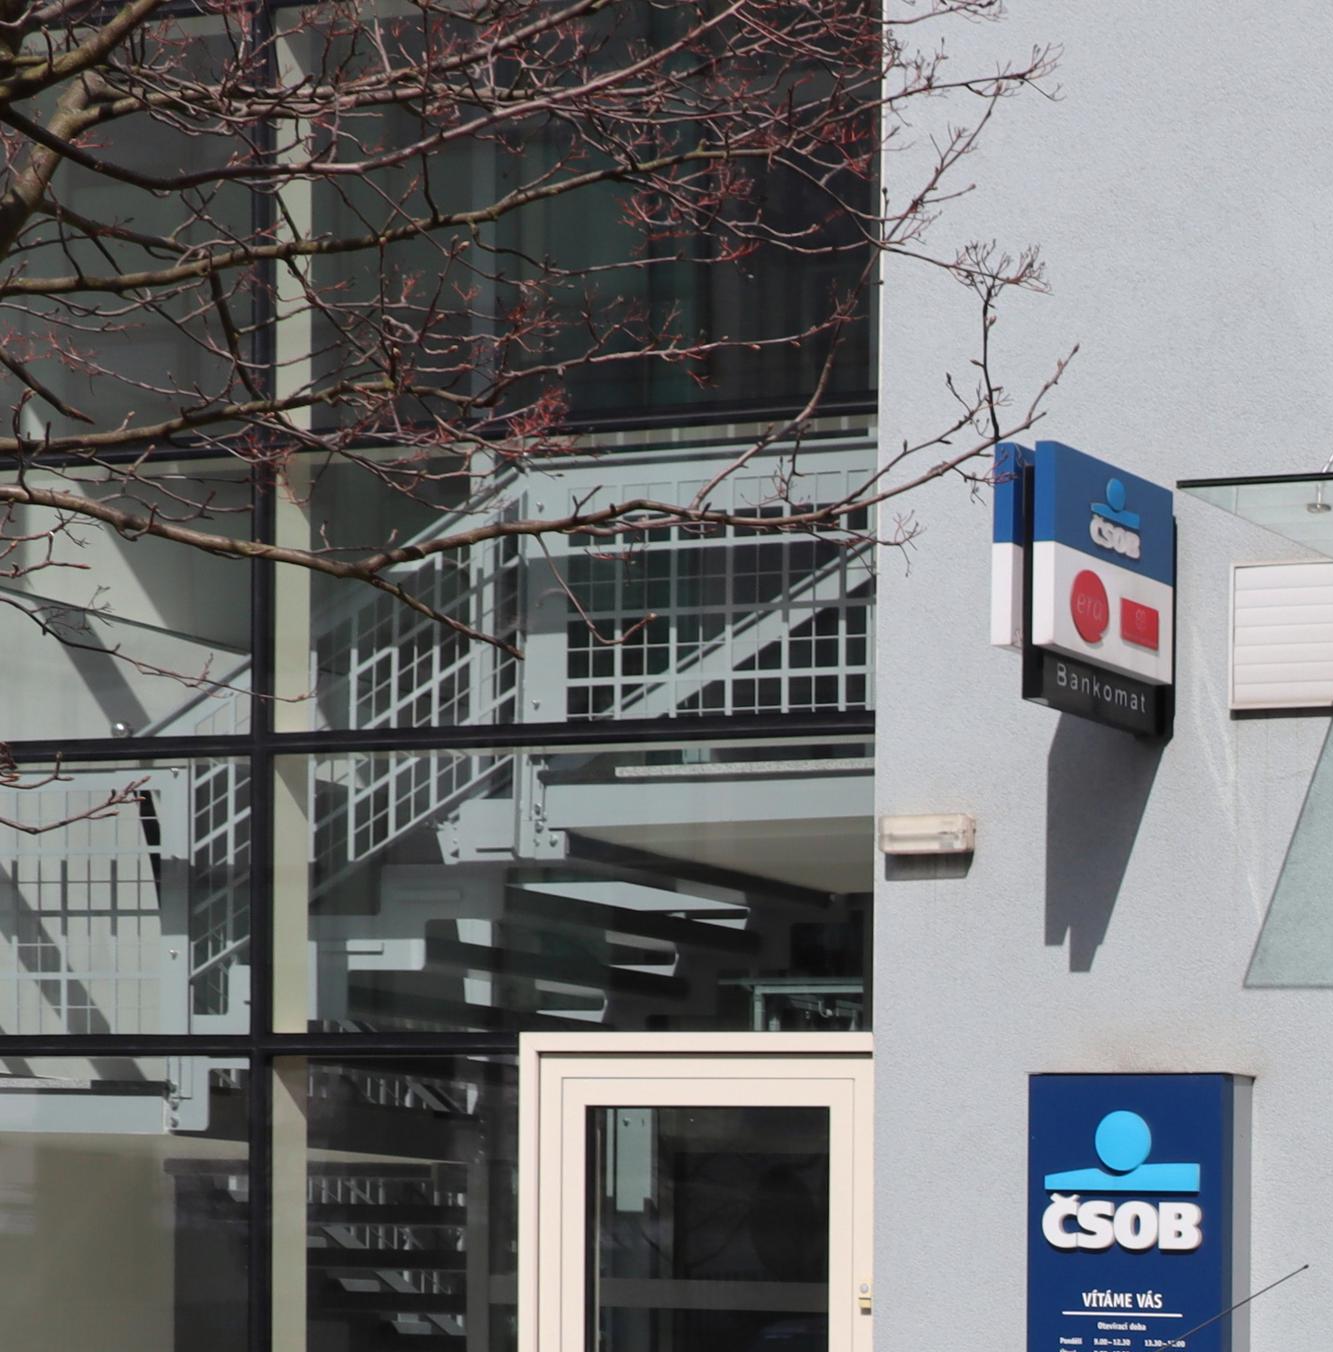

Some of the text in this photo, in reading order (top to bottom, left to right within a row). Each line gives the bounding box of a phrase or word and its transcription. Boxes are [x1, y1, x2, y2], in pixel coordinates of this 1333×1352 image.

[1089, 515, 1140, 559] ČSOB
[1076, 593, 1103, 621] era
[1056, 663, 1147, 712] Bankomat
[1042, 1193, 1202, 1251] ČSOB
[1082, 1289, 1163, 1309] VÍTÁME VÁS
